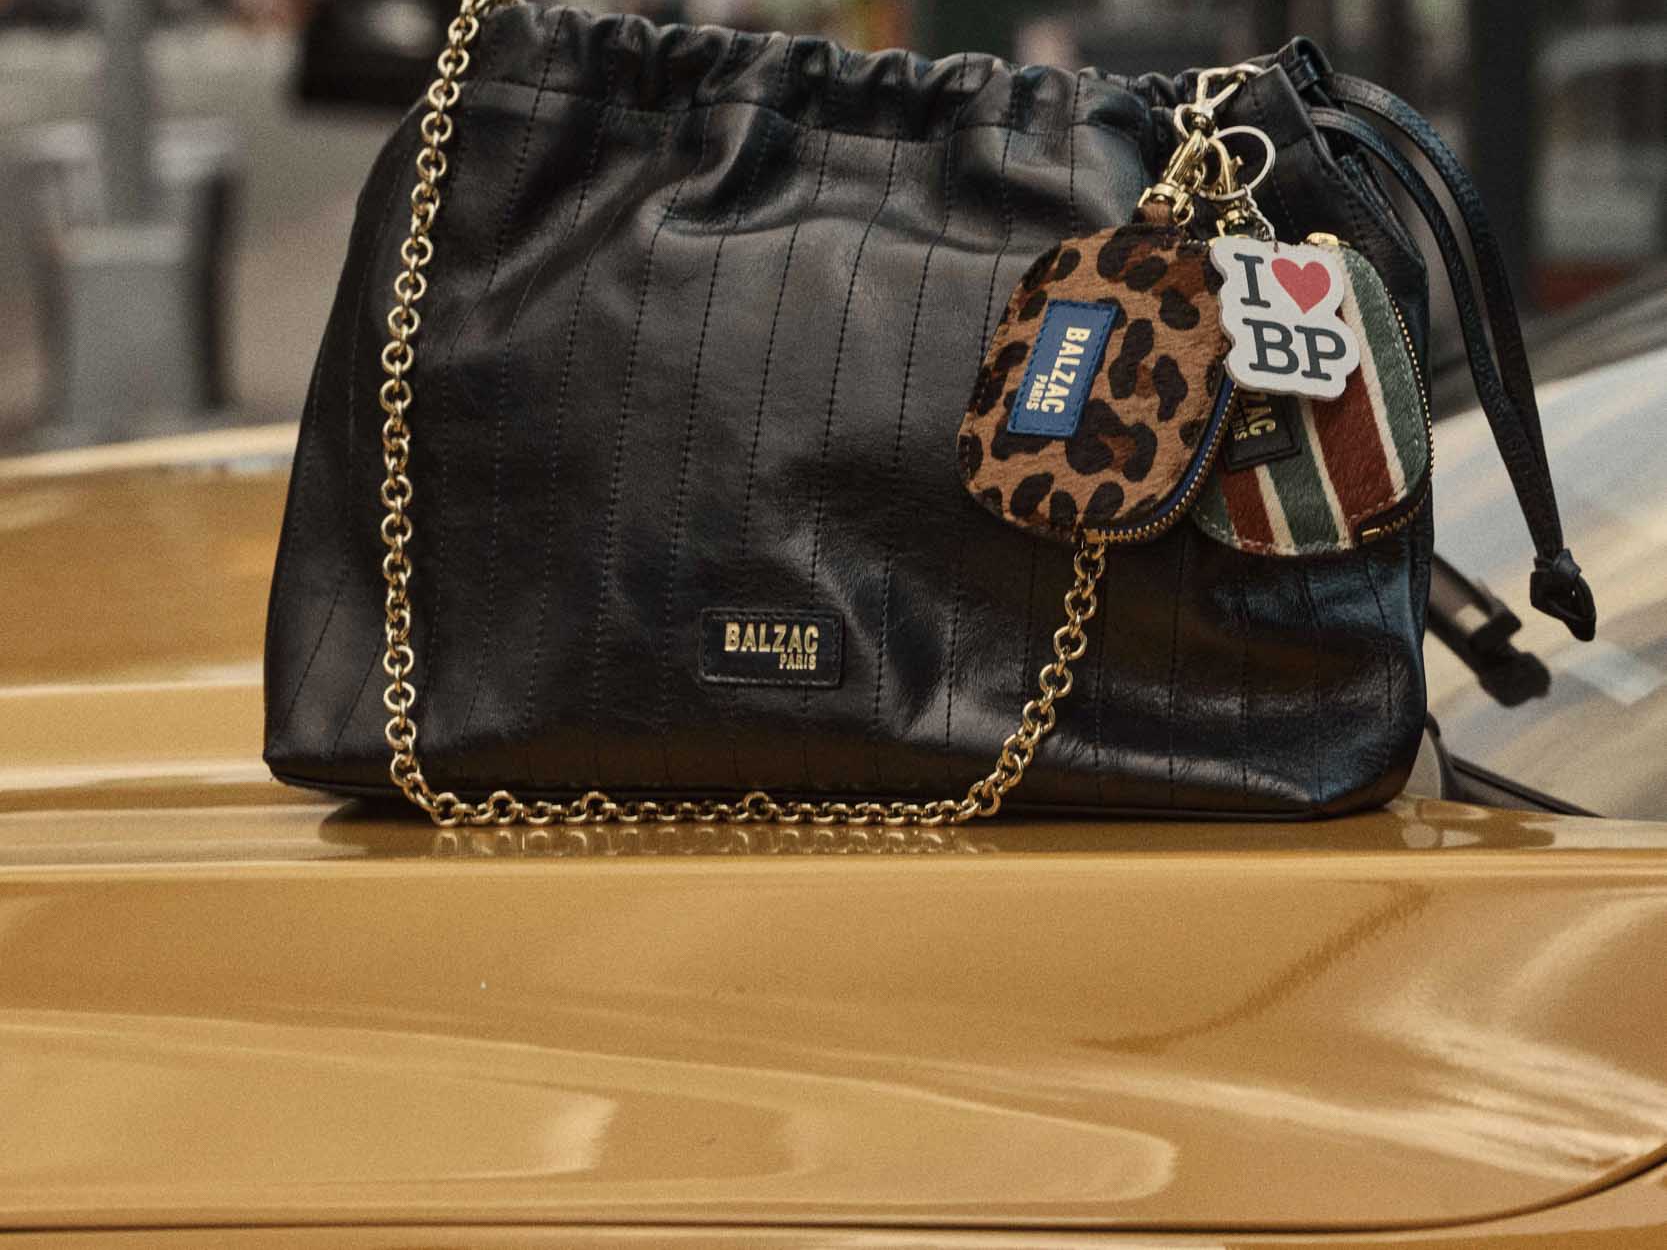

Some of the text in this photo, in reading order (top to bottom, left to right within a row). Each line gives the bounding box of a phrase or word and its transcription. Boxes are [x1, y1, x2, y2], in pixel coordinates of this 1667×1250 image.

[1233, 253, 1271, 308] I
[1041, 326, 1091, 413] BALZAC
[1242, 317, 1346, 381] BP
[1026, 374, 1049, 411] PARIS
[724, 622, 819, 653] BALZAC
[779, 653, 817, 670] PARIS
